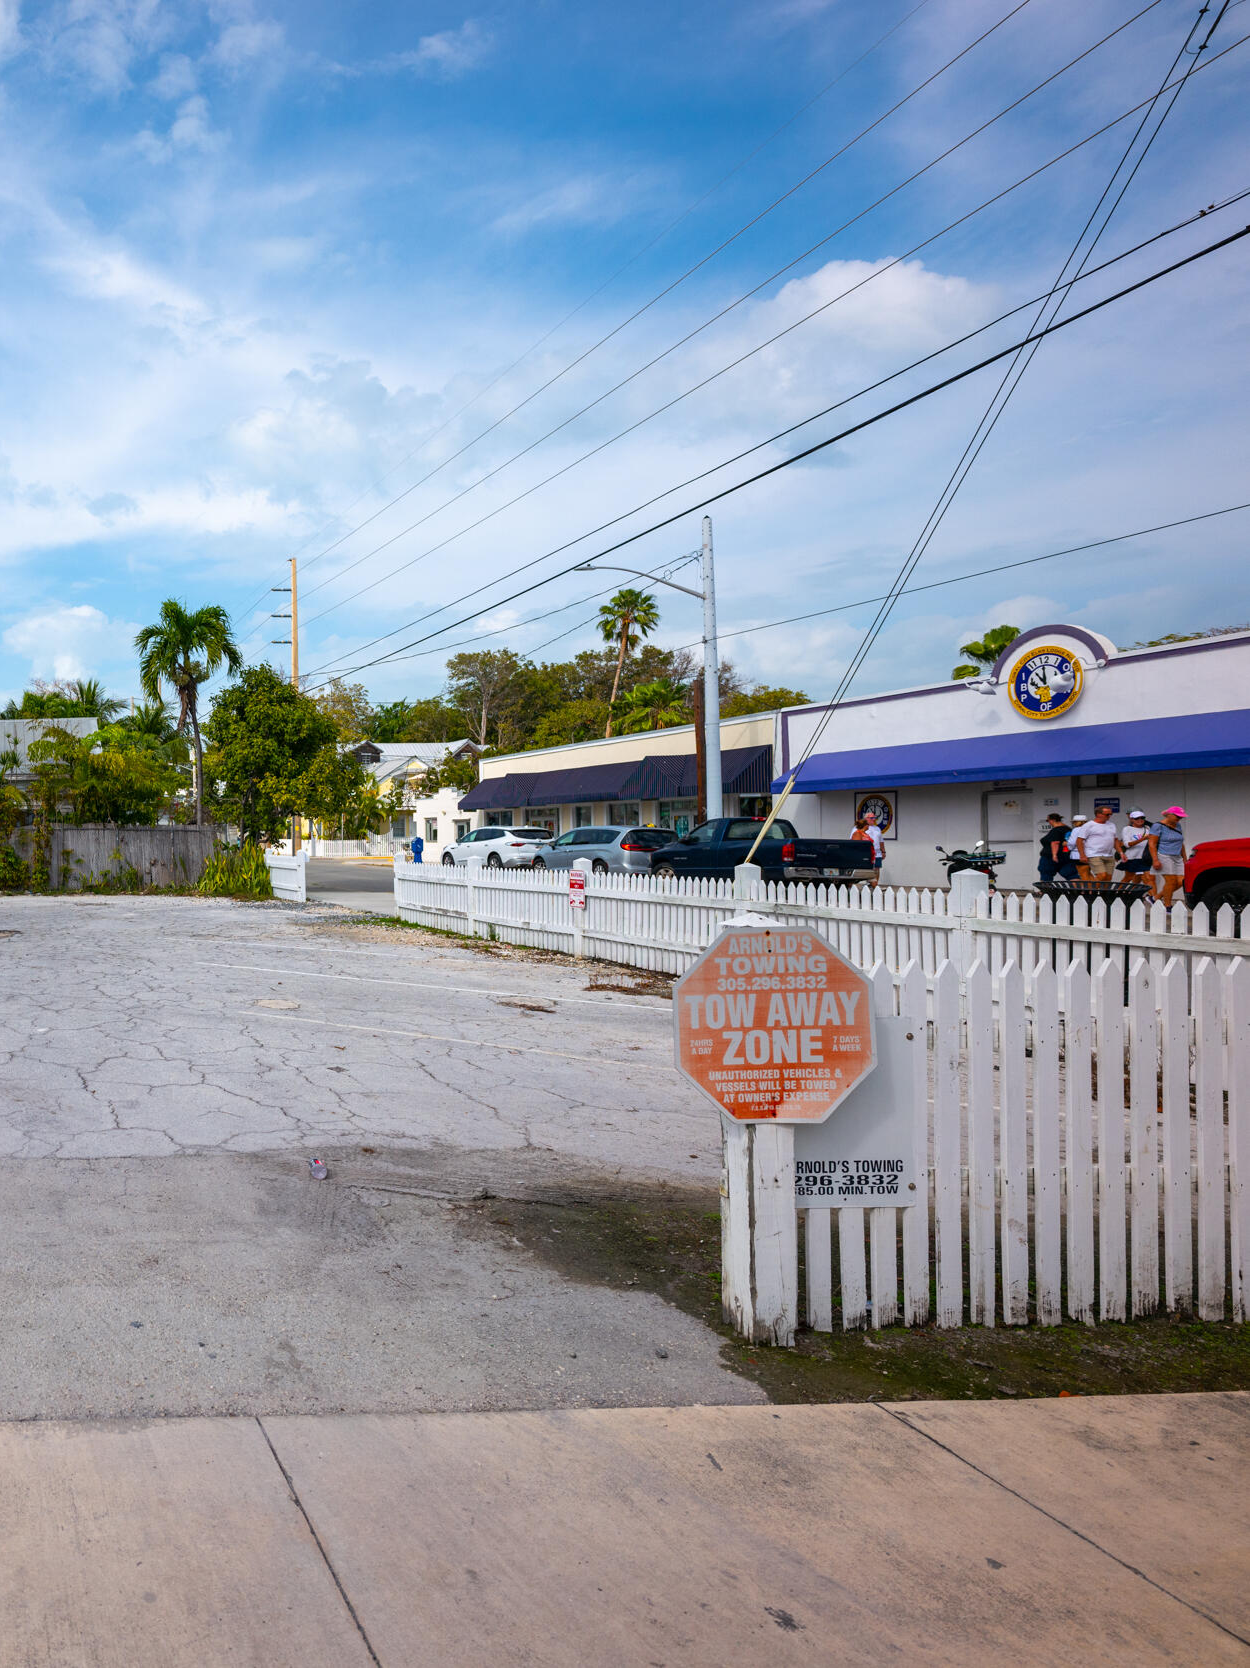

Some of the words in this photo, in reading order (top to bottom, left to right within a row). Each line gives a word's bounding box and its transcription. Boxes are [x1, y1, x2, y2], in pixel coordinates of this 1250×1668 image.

[1028, 660, 1037, 670] 11
[1039, 655, 1049, 665] 12
[1054, 657, 1059, 665] 1
[1039, 702, 1052, 712] OF
[728, 935, 812, 955] ARNOLD'S
[714, 956, 827, 975] TOWING
[717, 976, 827, 991] 305.296.3832
[685, 994, 756, 1029] TOW
[766, 992, 861, 1028] AWAY
[690, 1039, 713, 1047] 24HRS
[722, 1029, 824, 1065] ZONE
[839, 1043, 861, 1051] WEEK
[698, 1047, 712, 1055] DAY
[709, 1070, 780, 1081] UNAUTHORIZED
[783, 1068, 830, 1079] VEHICLES
[834, 1068, 842, 1078] &
[716, 1081, 757, 1092] VESSELS
[759, 1080, 781, 1091] WILL
[784, 1080, 797, 1090] BE
[801, 1079, 837, 1090] TOWED
[724, 1093, 735, 1103] AT
[738, 1092, 780, 1102] OWNER'S
[783, 1091, 830, 1102] EXPENSE
[795, 1160, 850, 1174] RNOLD'S
[854, 1159, 904, 1173] TOWING
[794, 1174, 899, 1187] 296-3832
[794, 1186, 834, 1196] 85.00
